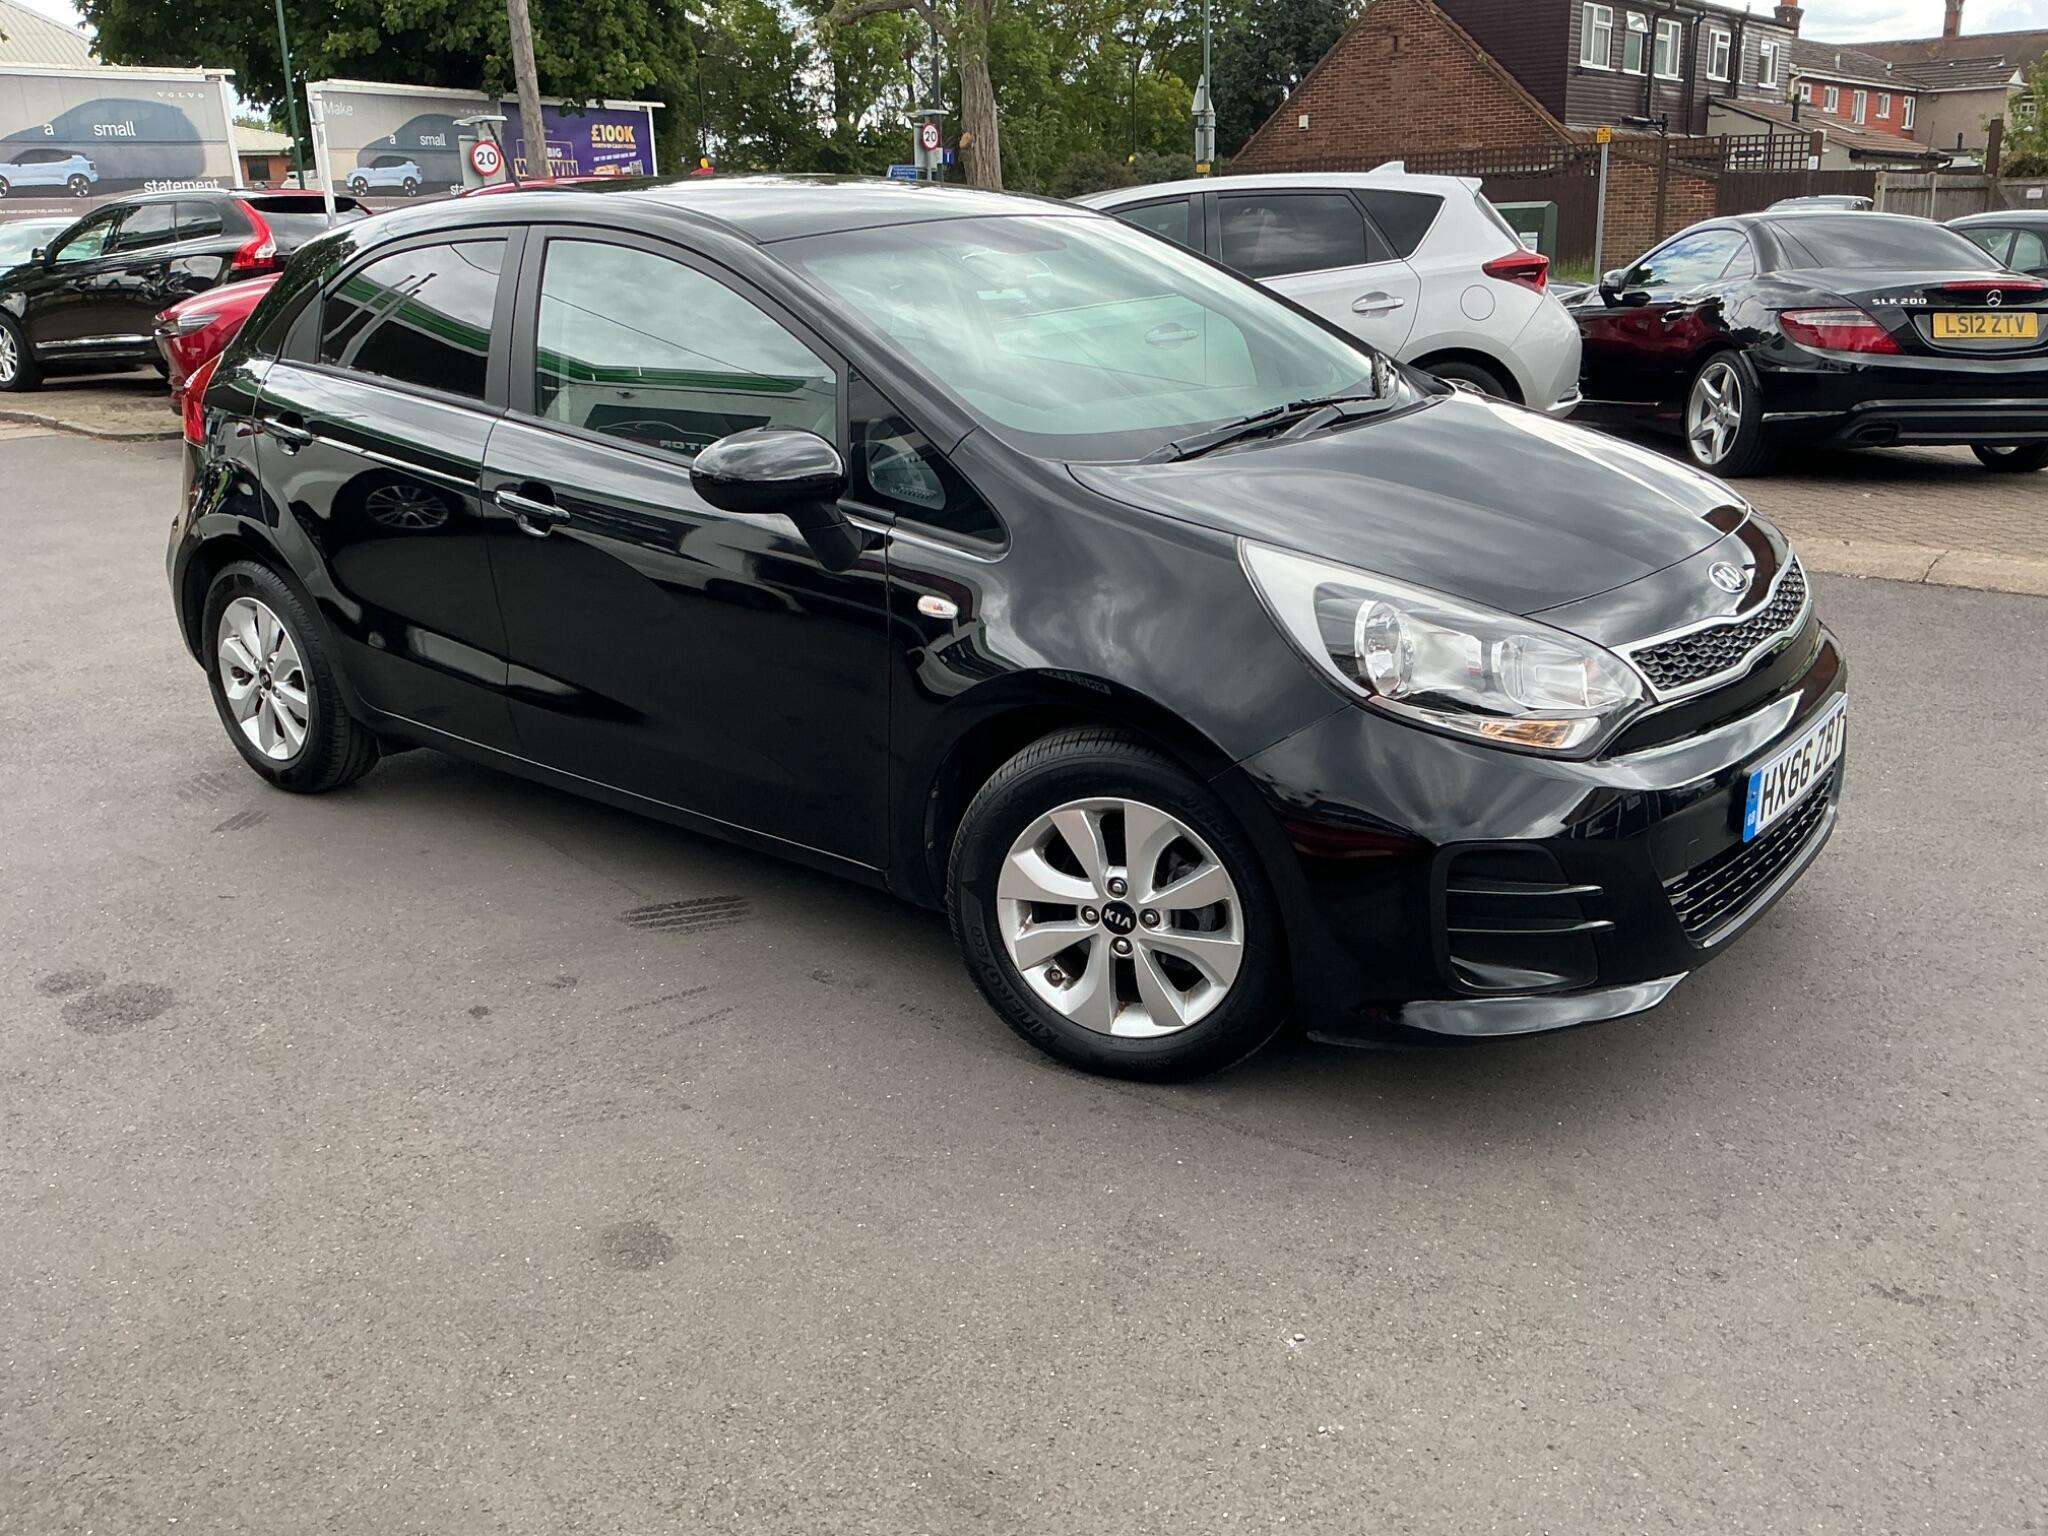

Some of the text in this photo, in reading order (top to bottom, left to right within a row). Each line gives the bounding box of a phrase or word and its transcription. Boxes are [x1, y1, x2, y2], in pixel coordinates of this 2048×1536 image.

[323, 100, 353, 116] Make
[43, 120, 136, 137] a small
[591, 123, 636, 143] £100K
[389, 132, 447, 146] a small
[925, 131, 936, 142] 20
[476, 151, 497, 165] 20
[546, 146, 563, 158] BIG
[143, 179, 219, 192] statement
[1871, 297, 1928, 306] SLK 200
[1945, 314, 2025, 334] LS12 ZTV
[1760, 738, 1813, 822] HX66
[1104, 908, 1132, 929] KIA
